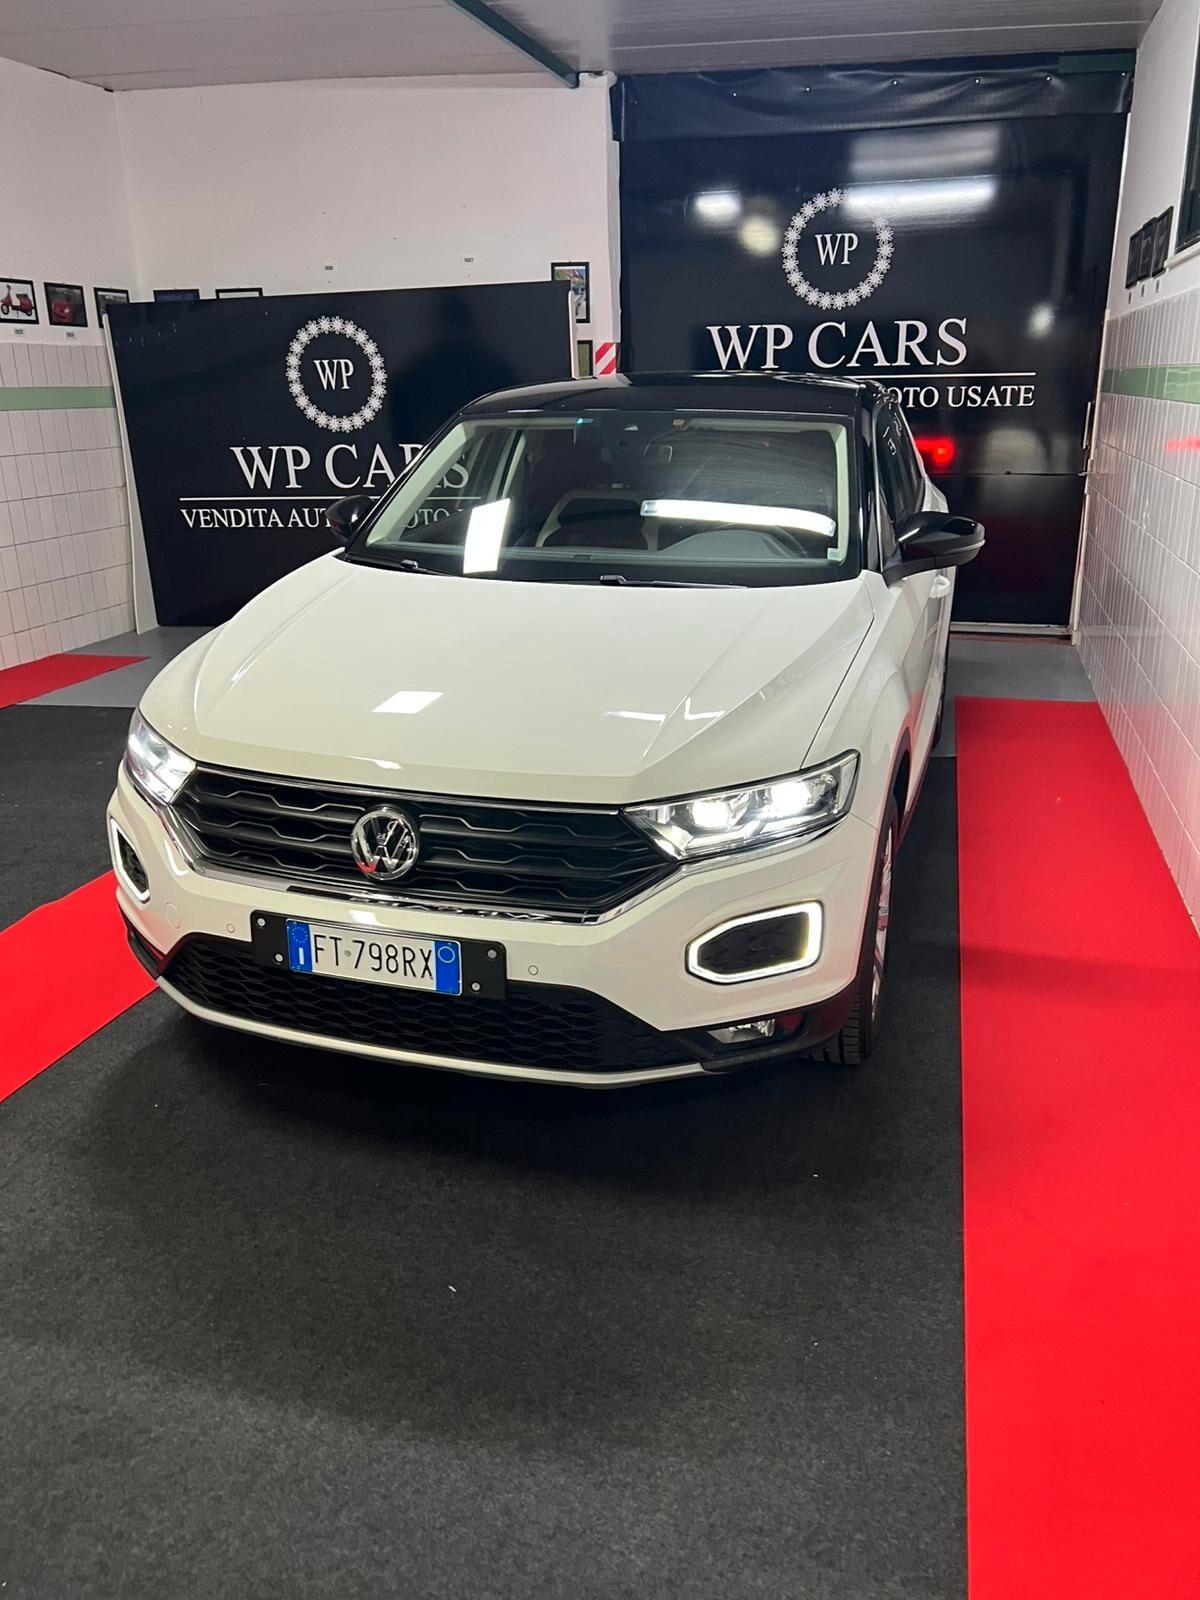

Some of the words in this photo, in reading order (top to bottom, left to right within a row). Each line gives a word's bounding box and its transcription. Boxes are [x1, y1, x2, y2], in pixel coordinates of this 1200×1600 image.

[815, 233, 859, 266] WP
[706, 324, 794, 370] WP
[807, 318, 968, 368] CARS
[313, 359, 355, 391] WP
[887, 386, 939, 408] OTO
[947, 385, 1035, 408] USATE
[230, 446, 311, 490] WP
[180, 508, 284, 528] VENDITA
[287, 508, 331, 528] AUT
